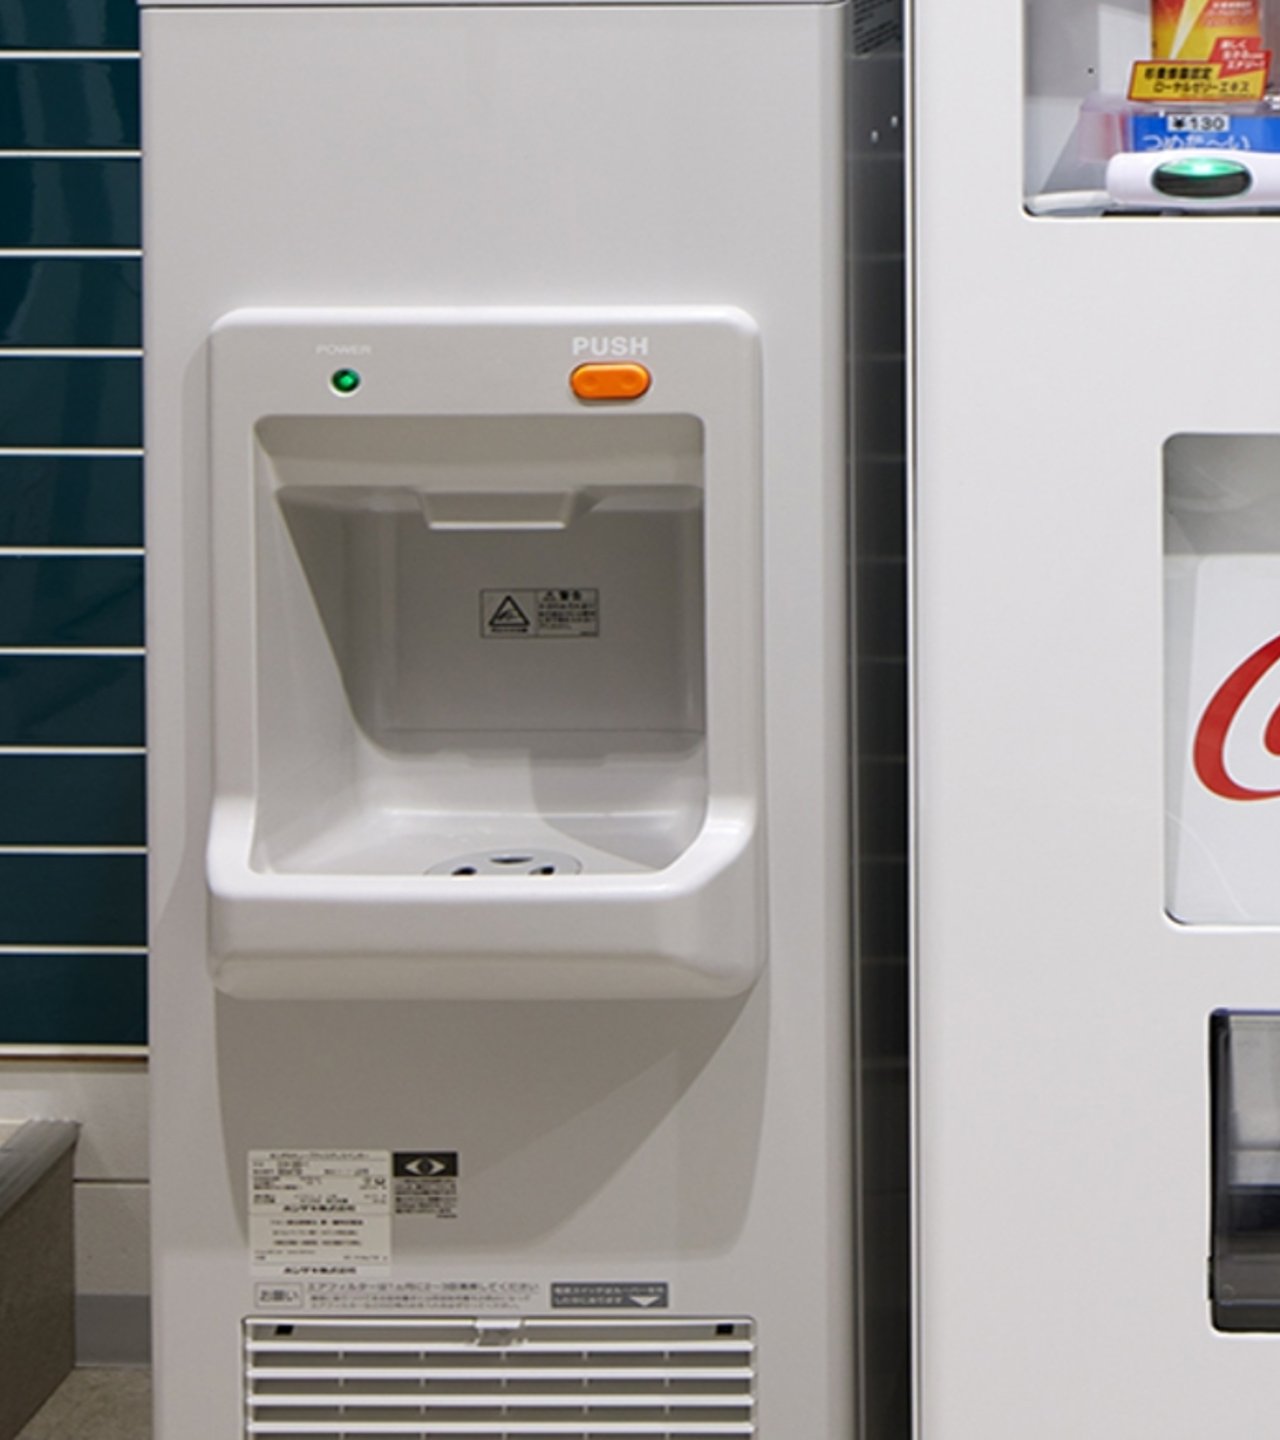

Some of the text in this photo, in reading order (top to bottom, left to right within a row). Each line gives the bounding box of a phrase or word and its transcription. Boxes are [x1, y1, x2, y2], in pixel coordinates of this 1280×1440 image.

[1173, 117, 1225, 130] ¥130
[316, 344, 373, 357] POWER
[571, 336, 650, 357] PUSH
